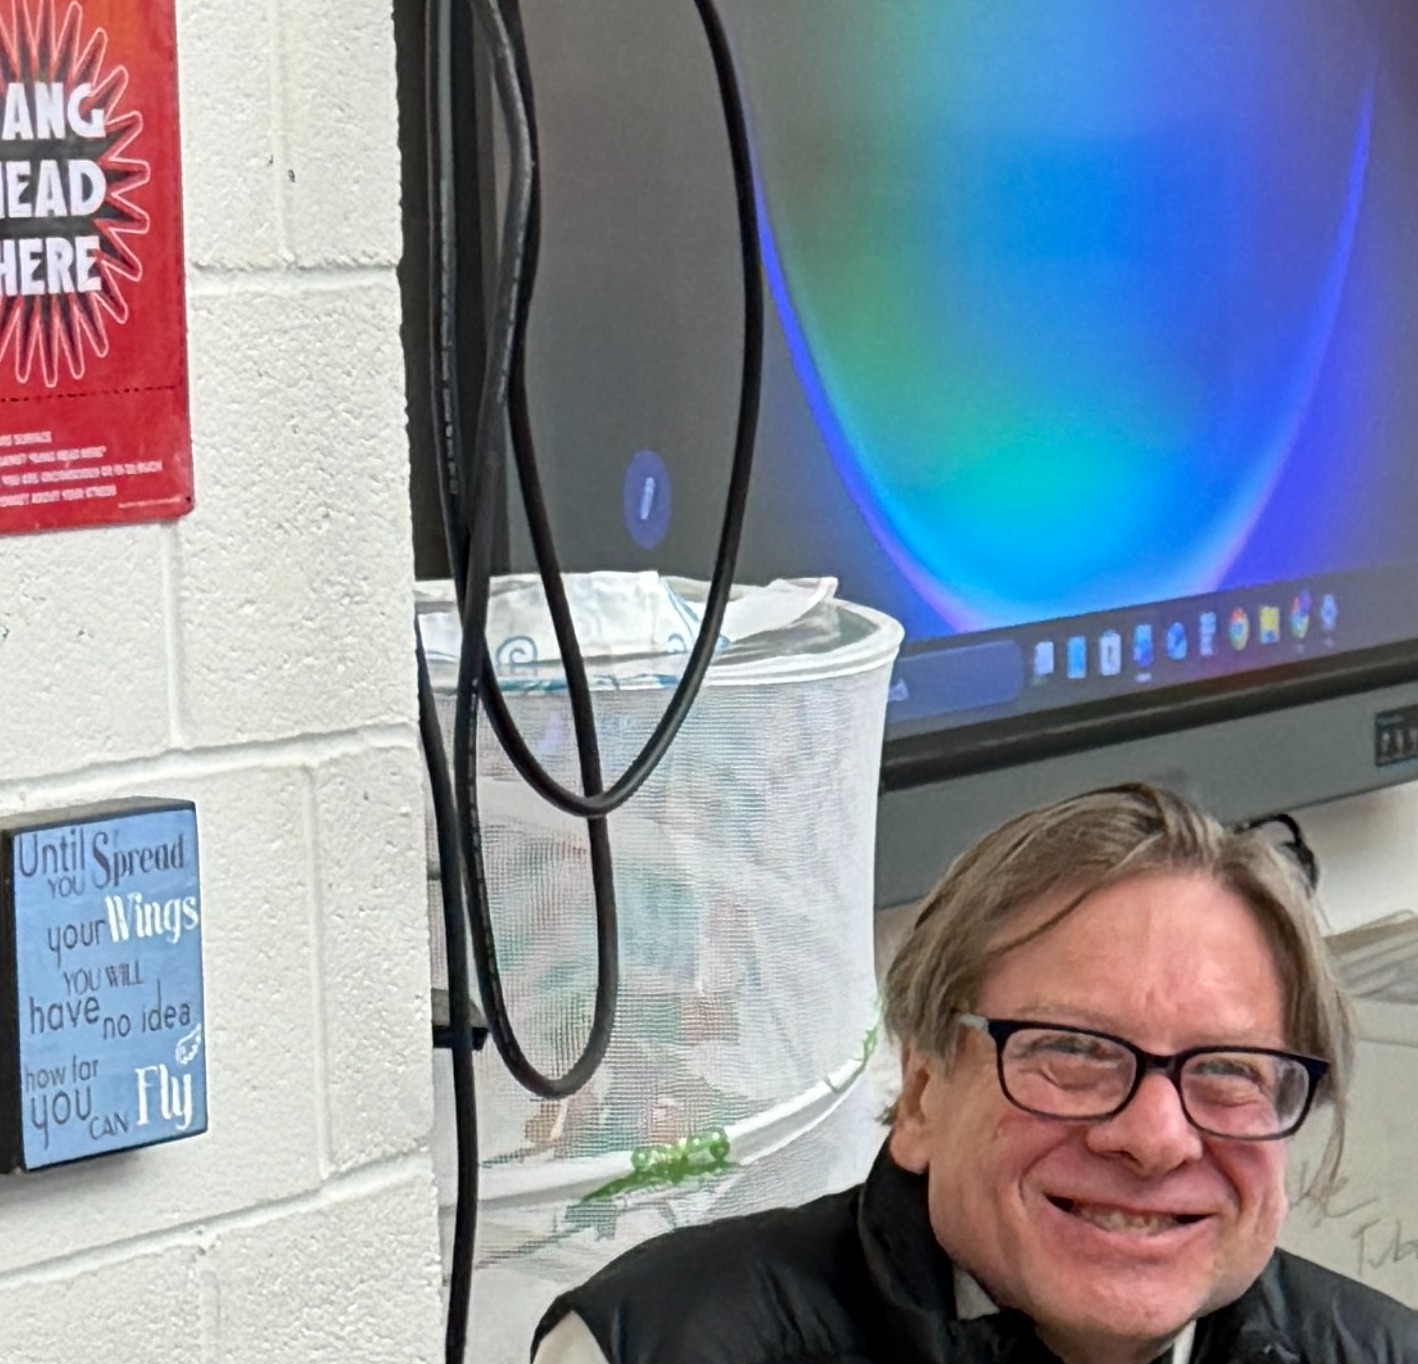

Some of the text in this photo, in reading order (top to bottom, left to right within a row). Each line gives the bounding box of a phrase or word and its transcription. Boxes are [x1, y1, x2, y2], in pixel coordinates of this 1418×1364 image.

[2, 82, 106, 141] ANG
[18, 828, 185, 889] Until Spread
[48, 891, 199, 970] your Wings
[63, 959, 145, 997] YOU WILL
[29, 978, 191, 1040] have no idea
[25, 1064, 67, 1093] how
[90, 1062, 193, 1141] CAN Fly
[31, 1087, 92, 1151] you
